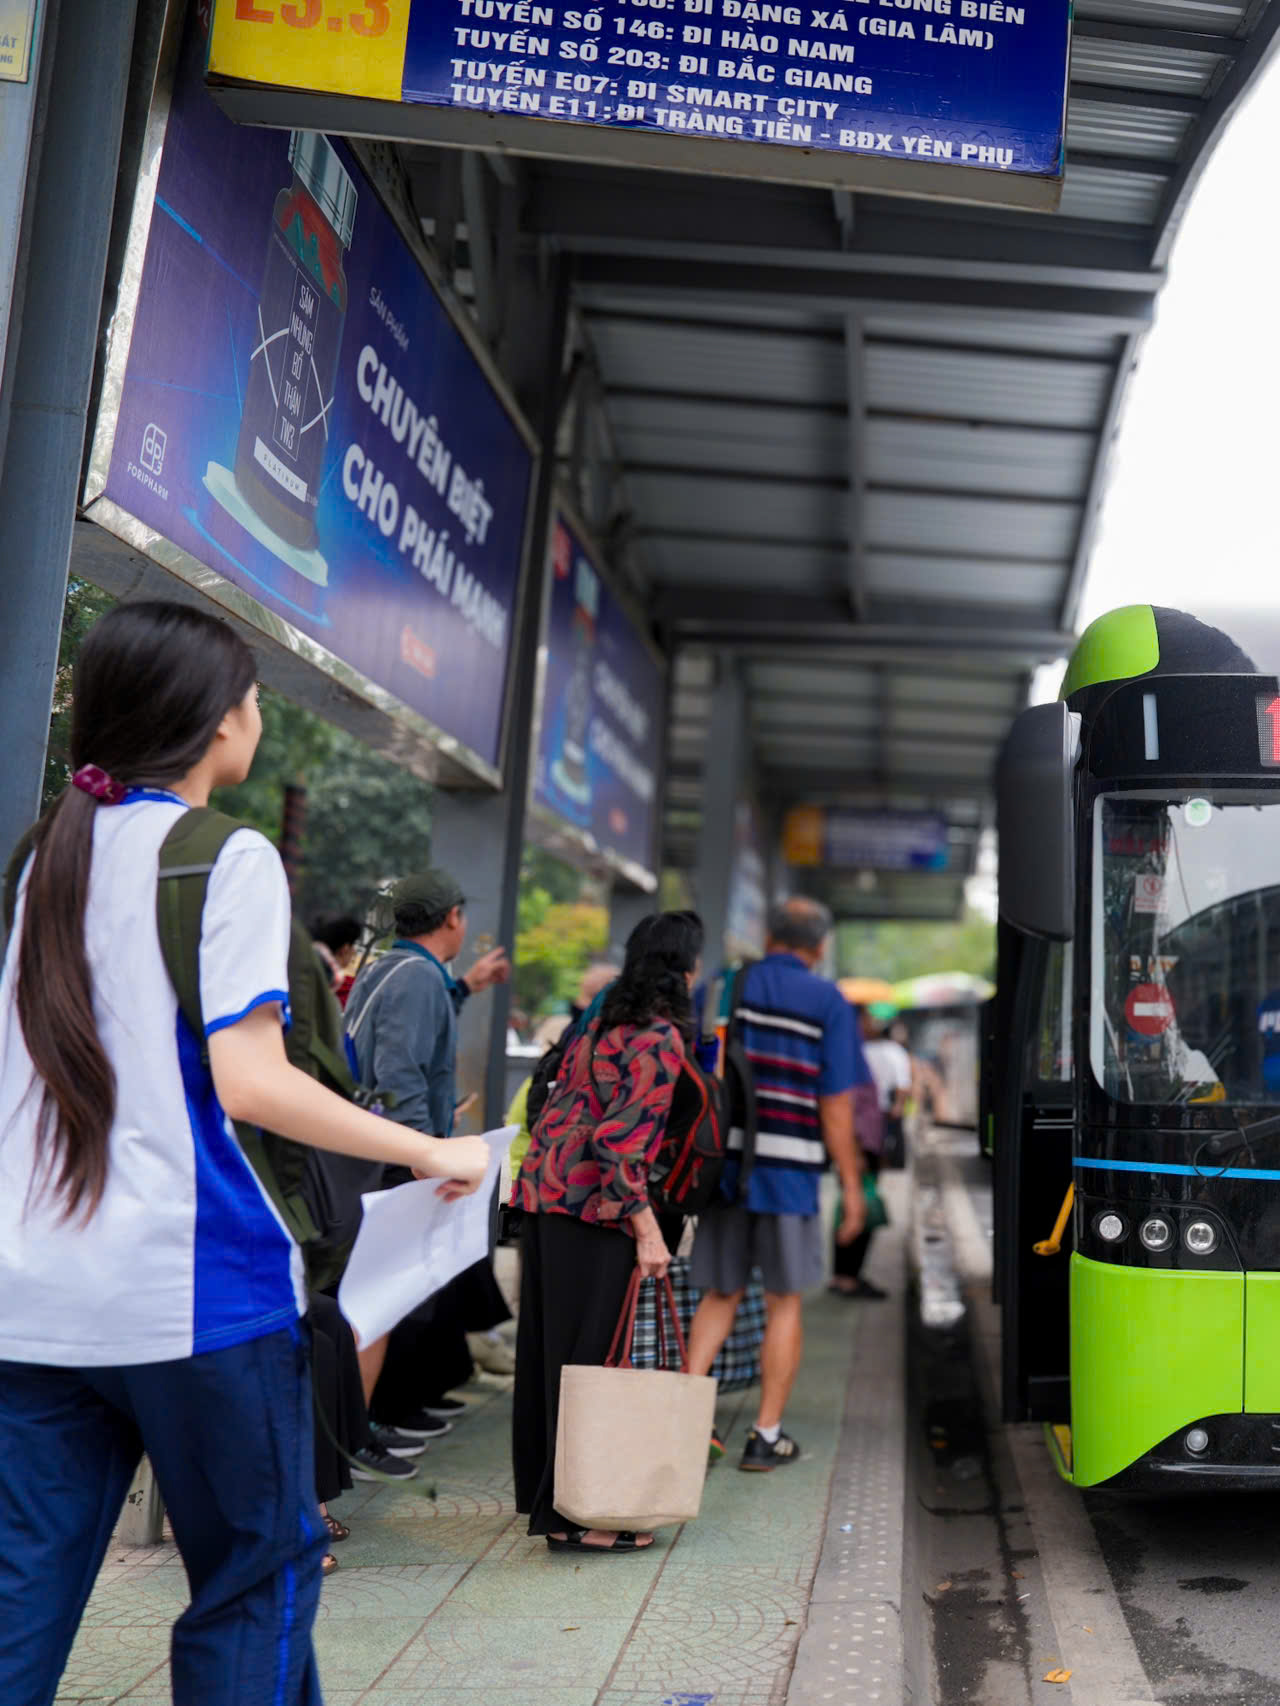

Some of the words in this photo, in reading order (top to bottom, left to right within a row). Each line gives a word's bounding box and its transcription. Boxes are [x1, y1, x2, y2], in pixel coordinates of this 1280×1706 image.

[458, 0, 553, 26] TUYẾN
[562, 7, 603, 32] SỐ
[613, 17, 674, 41] 146:
[682, 25, 712, 46] ĐI
[720, 26, 779, 54] HÀO
[788, 38, 855, 63] NAM
[810, 9, 849, 32] XÁ
[858, 16, 916, 40] (GIA
[924, 22, 995, 50] LÂM)
[960, 0, 1025, 25] BIÊN
[450, 58, 547, 88] TUYẾN
[554, 71, 618, 96] E07:
[626, 79, 657, 101] ĐI
[665, 84, 769, 112] SMART
[776, 96, 840, 121] CITY
[453, 27, 550, 56] TUYẾN
[558, 37, 601, 62] SỐ
[607, 46, 670, 71] 203:
[678, 54, 708, 76] ĐI
[717, 55, 776, 83] BẮC
[784, 68, 873, 95] GIANG
[450, 83, 541, 112] TUYẾN
[654, 107, 744, 135] TRÀNG
[752, 115, 812, 143] TIỀN
[839, 128, 893, 152] BĐX
[902, 133, 952, 159] YÊN
[961, 143, 1014, 169] PHỤ
[279, 415, 296, 451] TW3
[356, 344, 452, 497] CHUYÊN
[126, 460, 169, 502] FORIPHARM
[342, 443, 399, 537] CHO
[398, 504, 457, 597] PHÁI
